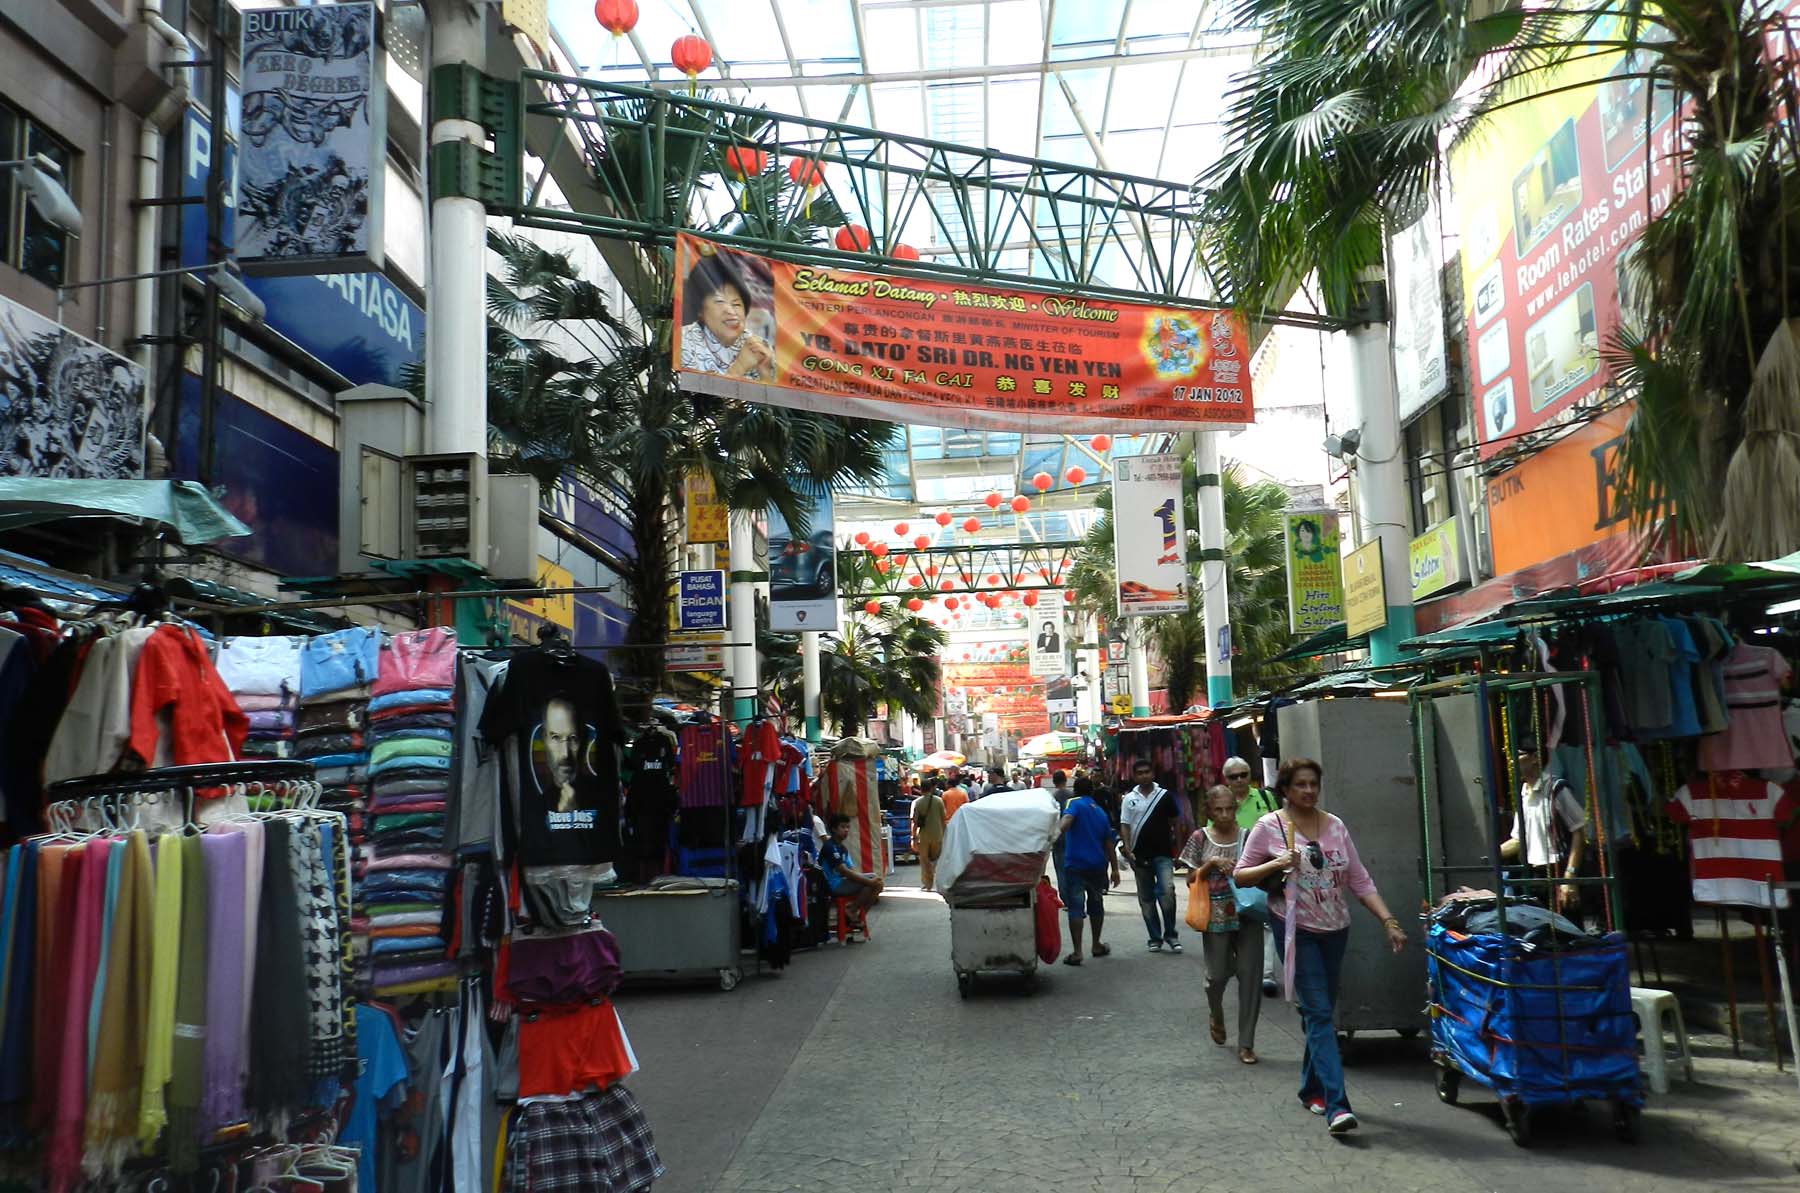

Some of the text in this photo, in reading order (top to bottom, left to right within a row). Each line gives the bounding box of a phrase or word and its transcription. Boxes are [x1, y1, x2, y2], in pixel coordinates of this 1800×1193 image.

[247, 10, 309, 32] BUTIK
[255, 55, 312, 74] ZERO
[284, 73, 361, 94] DEGREE
[1517, 243, 1560, 296] Room
[1563, 198, 1609, 255] Rates
[793, 270, 936, 308] Selamat Datang
[952, 289, 1027, 313] 热烈欢迎
[315, 273, 413, 351] AHASA
[1042, 296, 1119, 322] Welcome
[1013, 321, 1120, 339] MINISTER OF TOURISM
[800, 331, 837, 354] YB.
[917, 346, 956, 366] SRI
[963, 350, 999, 369] DR.
[1005, 353, 1034, 371] NG
[1039, 356, 1078, 375] YEN
[1084, 361, 1121, 378] YEN
[802, 355, 975, 388] GONG XI FA CAI
[996, 376, 1120, 400] 恭喜发财
[1173, 386, 1187, 400] 17
[1189, 387, 1212, 402] JAN
[1216, 388, 1243, 403] 2012
[1490, 472, 1525, 506] BUTIK
[690, 575, 713, 583] PUSAT
